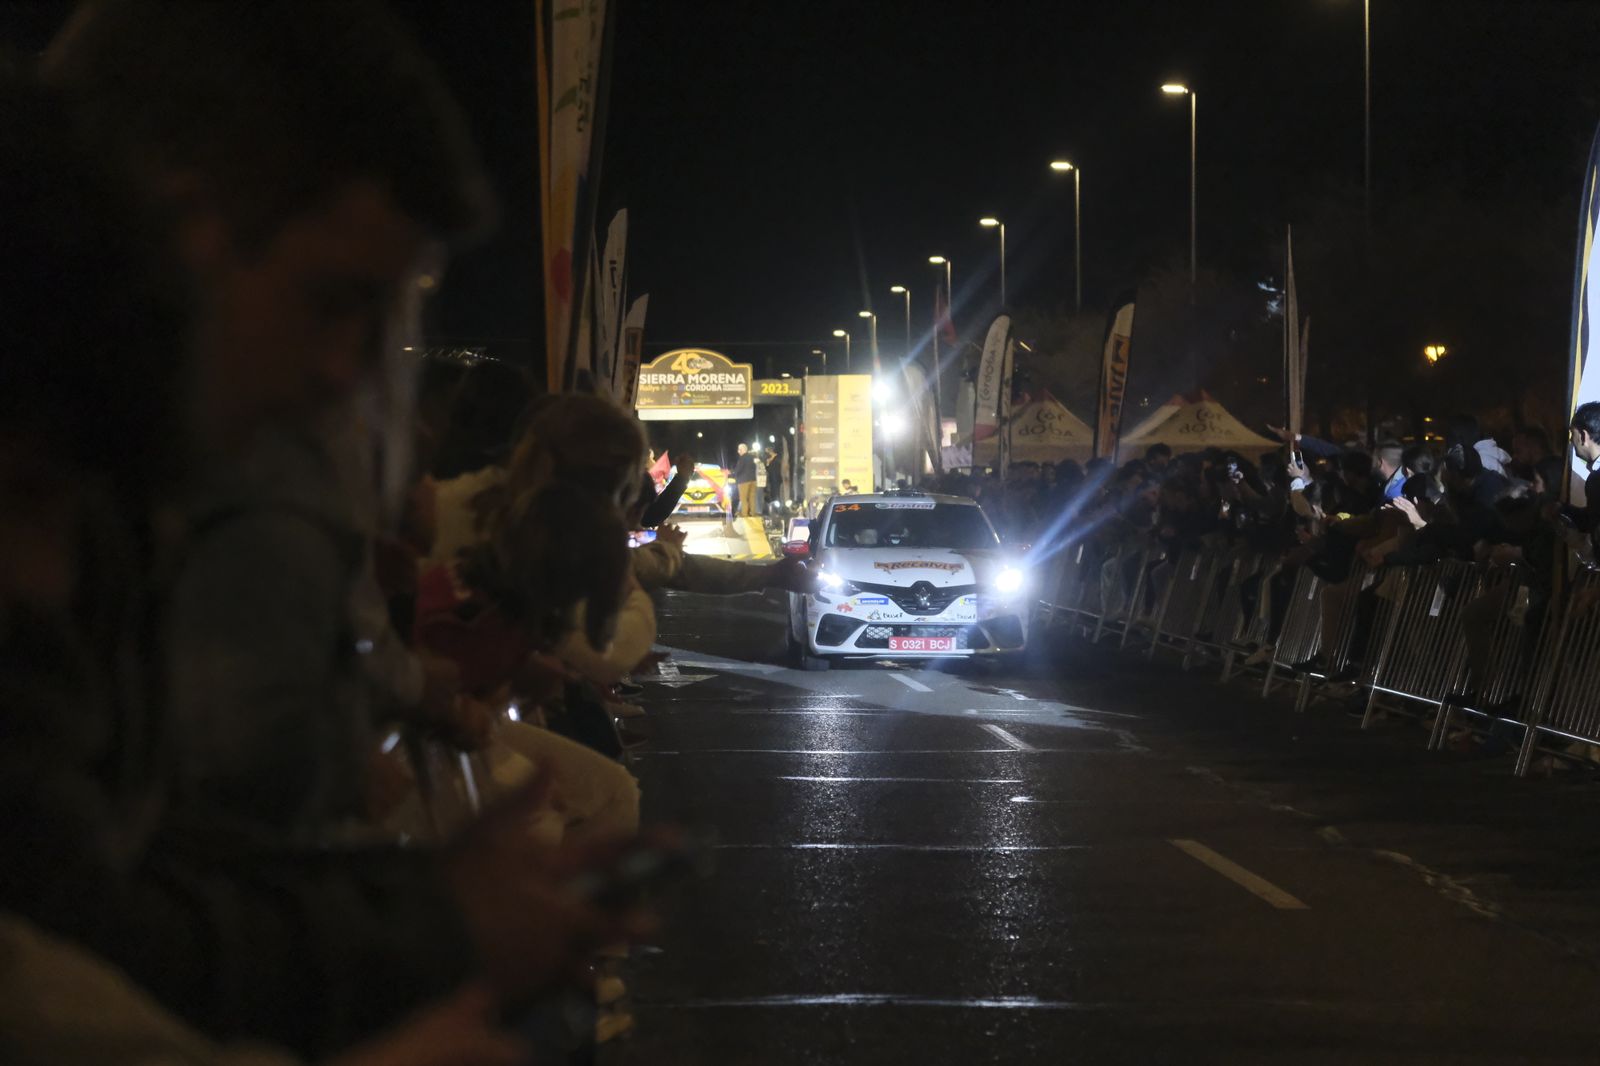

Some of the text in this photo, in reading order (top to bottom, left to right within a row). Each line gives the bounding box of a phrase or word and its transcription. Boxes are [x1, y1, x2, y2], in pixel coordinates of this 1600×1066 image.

[639, 373, 746, 385] SIERRA MORENA
[835, 503, 861, 513] 34
[890, 639, 950, 649] S 0321 BCJ
